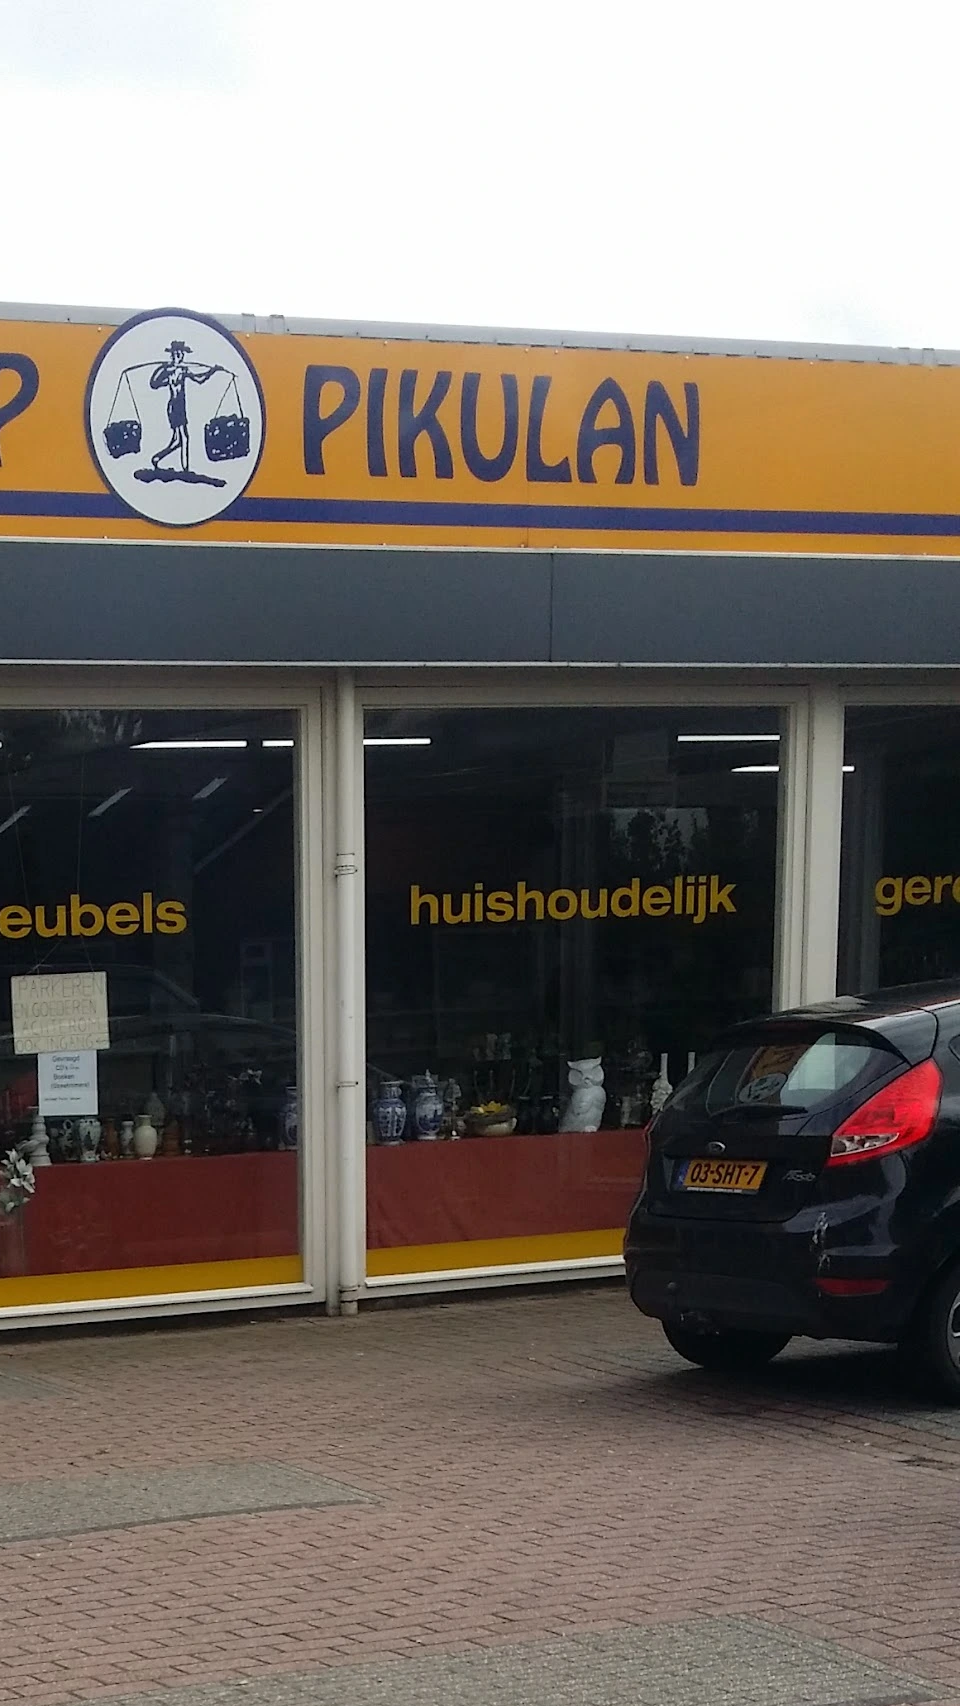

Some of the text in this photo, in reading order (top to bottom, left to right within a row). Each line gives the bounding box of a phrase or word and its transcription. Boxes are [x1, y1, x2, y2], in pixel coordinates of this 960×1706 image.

[303, 364, 700, 487] PIKULAN
[410, 875, 737, 925] huishoudelijk
[18, 974, 105, 998] PARKEREN
[31, 1000, 97, 1018] GOEDEREN
[690, 1162, 761, 1186] 03-SHT-7
